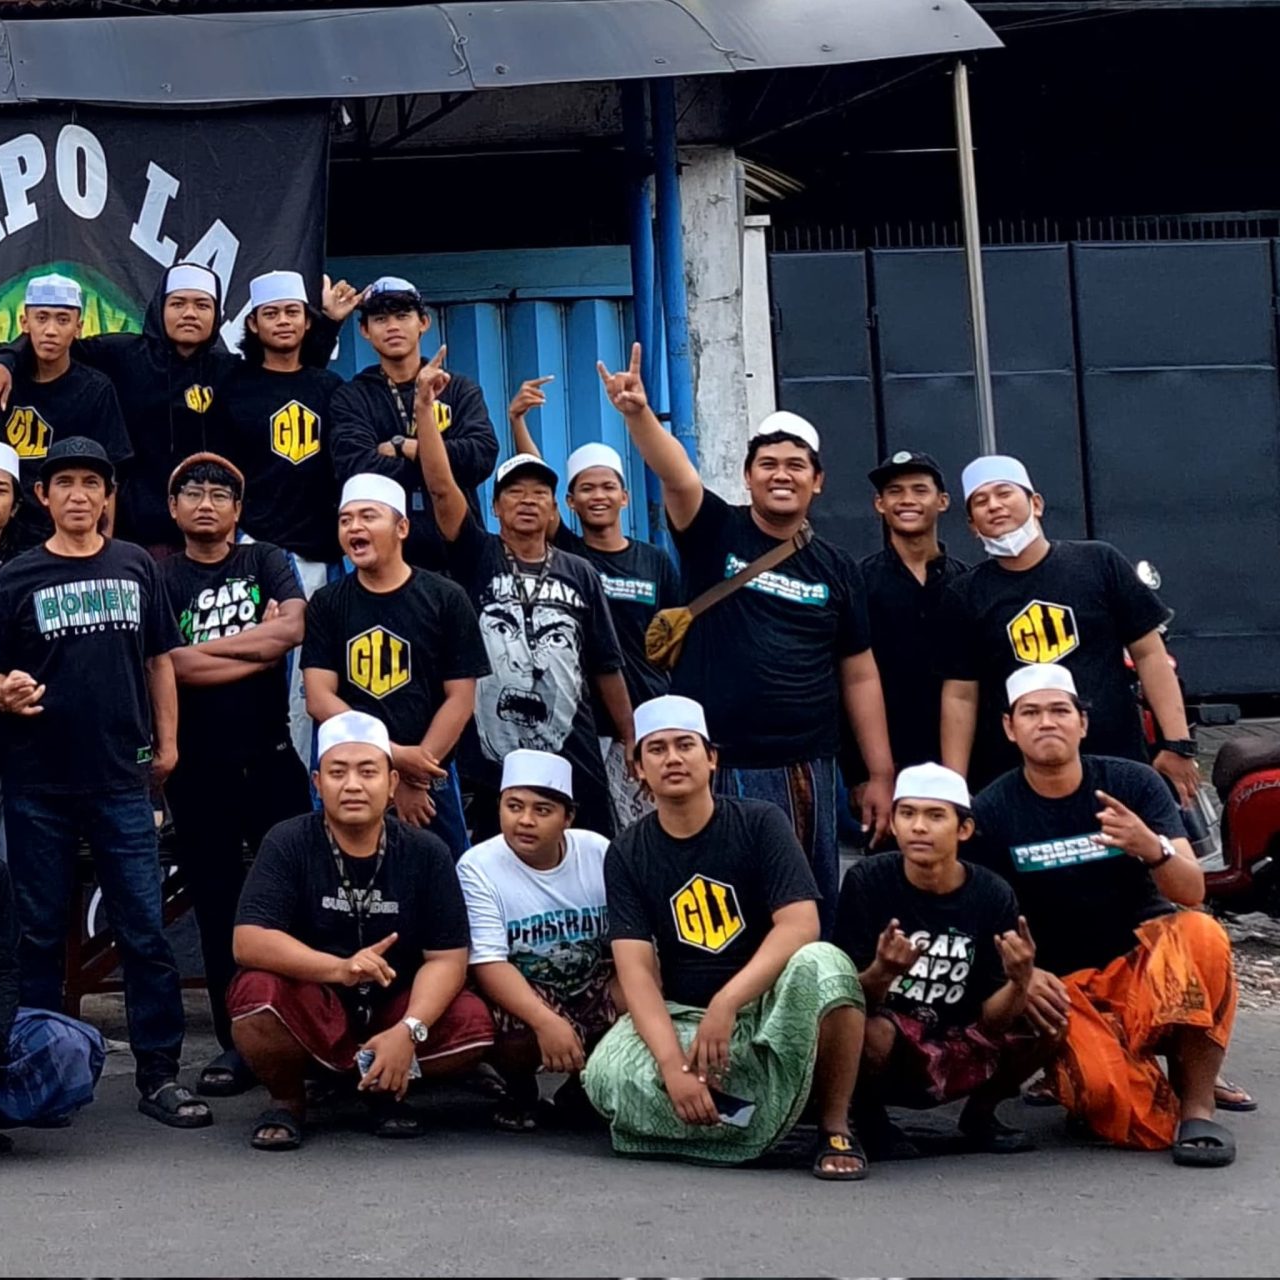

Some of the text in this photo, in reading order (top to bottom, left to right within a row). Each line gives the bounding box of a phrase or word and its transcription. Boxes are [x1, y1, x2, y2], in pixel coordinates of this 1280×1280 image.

[7, 407, 50, 458] GLL
[274, 403, 320, 461] GLL
[42, 588, 137, 620] BONEK
[198, 580, 249, 610] GAK
[74, 623, 106, 636] LAPO
[192, 600, 256, 633] LAPO
[1011, 604, 1076, 663] GLL
[351, 629, 408, 695] GLL
[676, 878, 741, 950] GLL
[909, 930, 972, 959] GAK
[908, 955, 970, 982] APO
[888, 975, 965, 1004] LAPO
